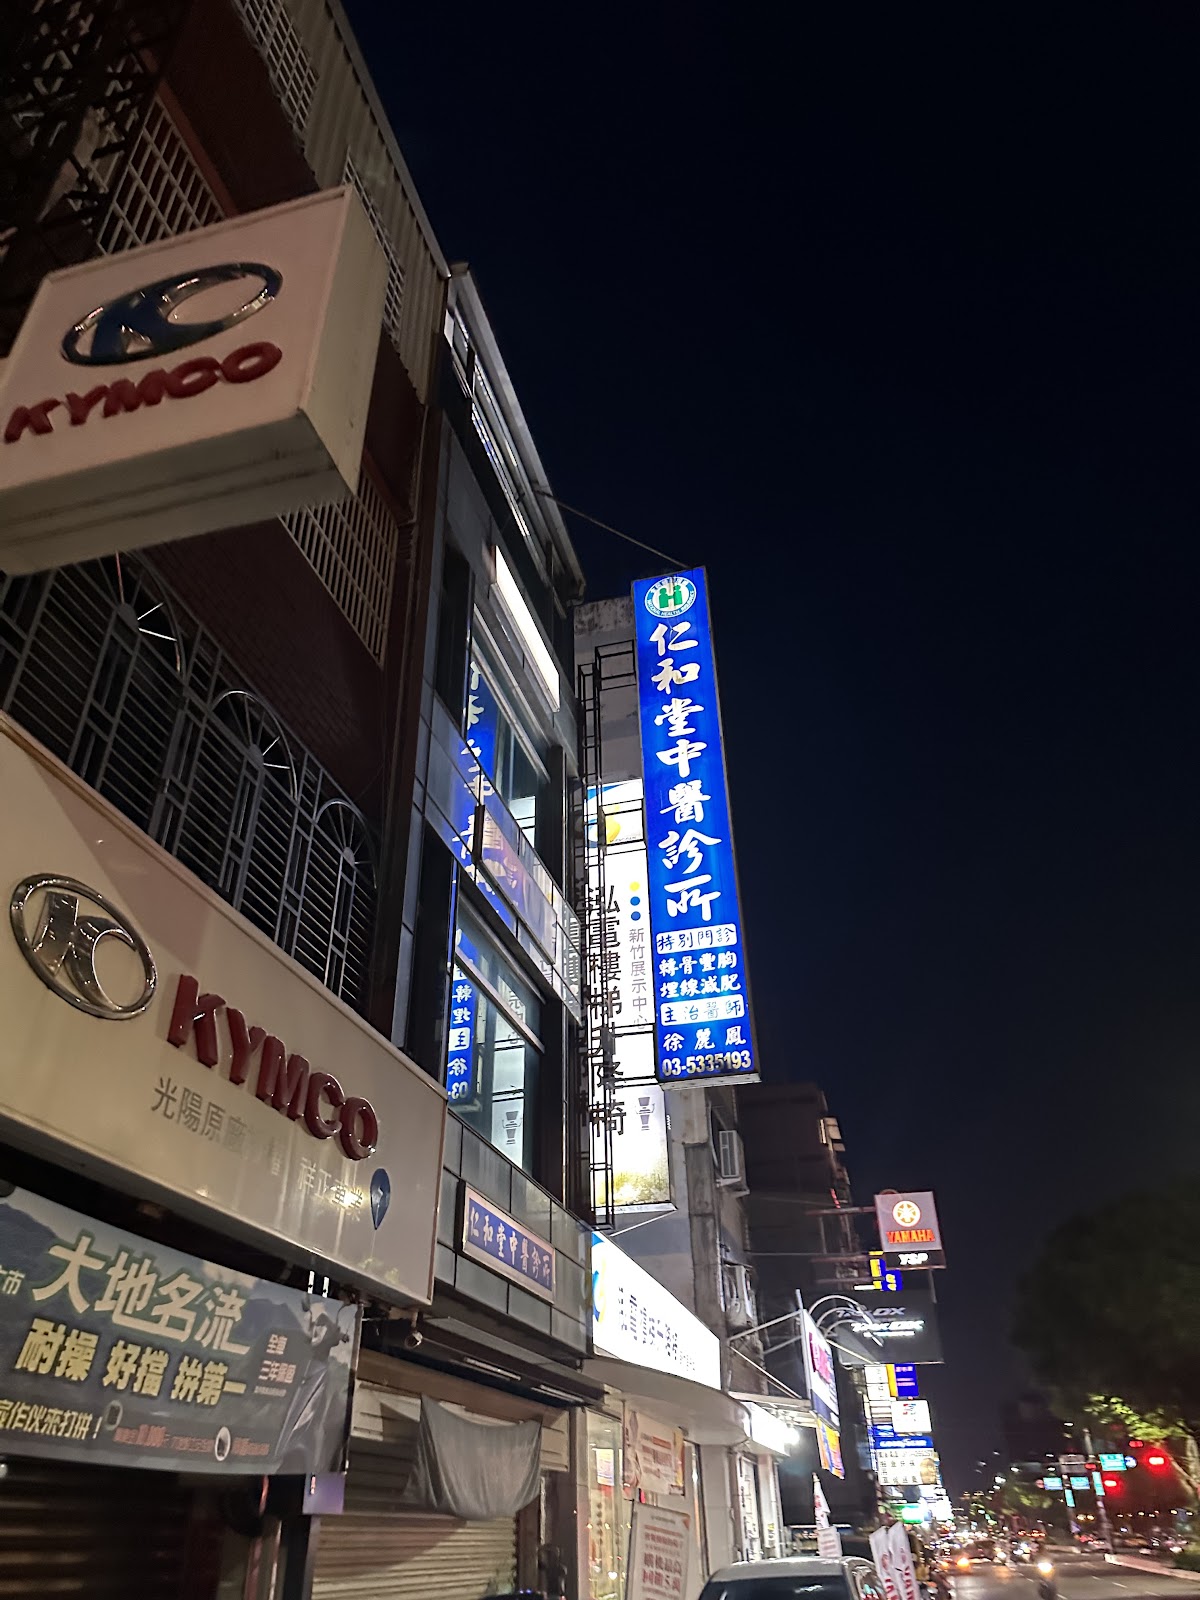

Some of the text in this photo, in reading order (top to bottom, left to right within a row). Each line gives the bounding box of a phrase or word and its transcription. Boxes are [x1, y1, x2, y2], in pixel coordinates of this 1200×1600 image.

[4, 341, 283, 443] KYMCO
[649, 620, 723, 922] 仁和堂中醫診所
[656, 927, 736, 952] 特別門診
[658, 950, 738, 977] 轉骨豐胸
[628, 927, 649, 1031] 新竹展示中心
[659, 973, 742, 999] 埋線減肥
[663, 1000, 742, 1024] 主治醫師
[662, 1026, 747, 1052] 徐麗鳳
[167, 973, 379, 1162] KYMCO
[661, 1050, 752, 1077] 03-5335193
[469, 1206, 552, 1287] 仁和堂中醫診所
[886, 1229, 936, 1245] YAMAHA
[898, 1252, 929, 1266] YSP
[0, 1264, 26, 1295] 市
[32, 1235, 251, 1356] 大地名流
[15, 1318, 99, 1382] 耐操
[102, 1340, 170, 1398] 好擋
